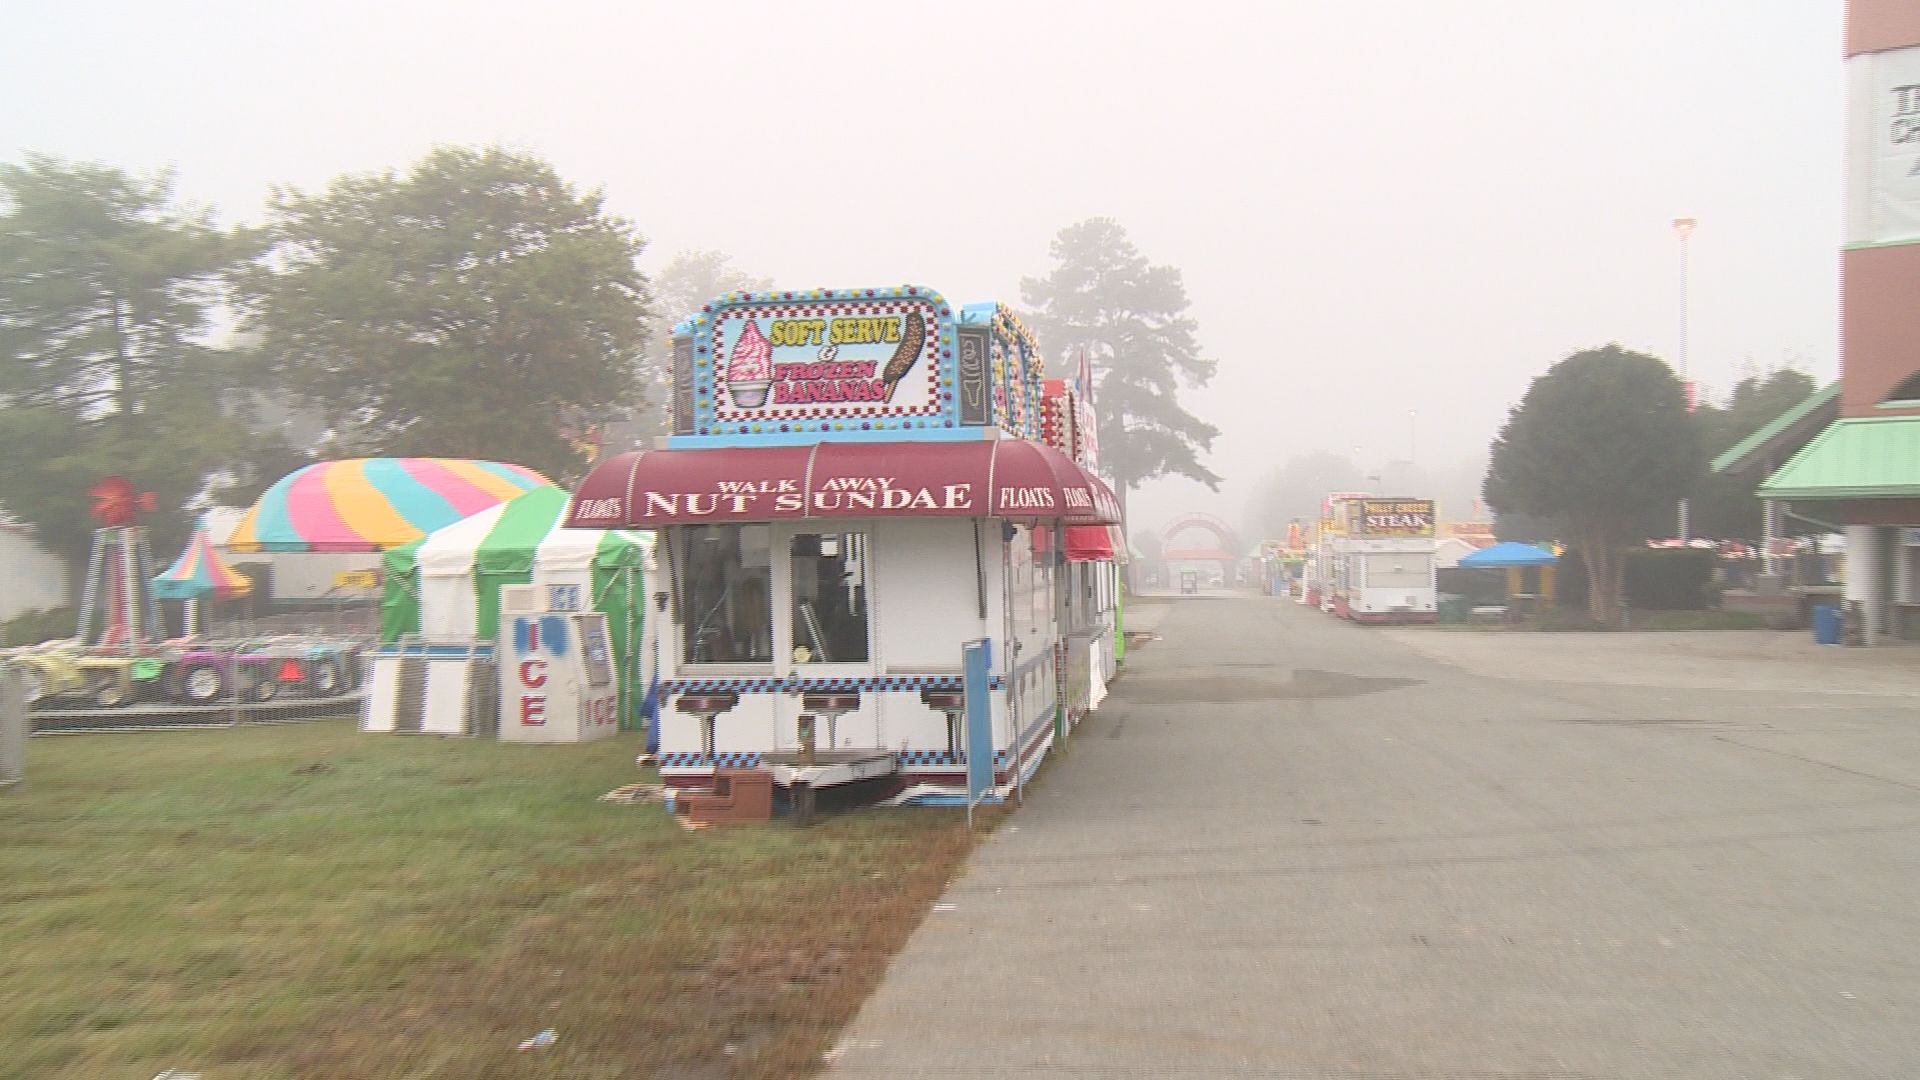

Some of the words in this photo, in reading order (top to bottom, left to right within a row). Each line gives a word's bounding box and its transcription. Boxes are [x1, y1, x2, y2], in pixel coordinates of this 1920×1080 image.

[770, 319, 827, 347] SOFT
[828, 316, 901, 345] SERVE
[818, 344, 838, 362] &
[773, 359, 878, 382] FROZEN
[773, 378, 886, 405] BANANAS
[717, 479, 799, 493] WALK
[821, 477, 897, 491] AWAY
[574, 497, 623, 520] FLOATS
[643, 491, 757, 517] NUT
[774, 482, 973, 512] SUNDAE
[999, 486, 1055, 509] FLOATS
[1363, 502, 1394, 513] PHILLY
[1395, 502, 1430, 513] CHEESE
[1365, 513, 1427, 528] STEAK
[551, 587, 579, 609] ICE
[518, 623, 548, 727] ICE
[584, 695, 617, 727] ICE
